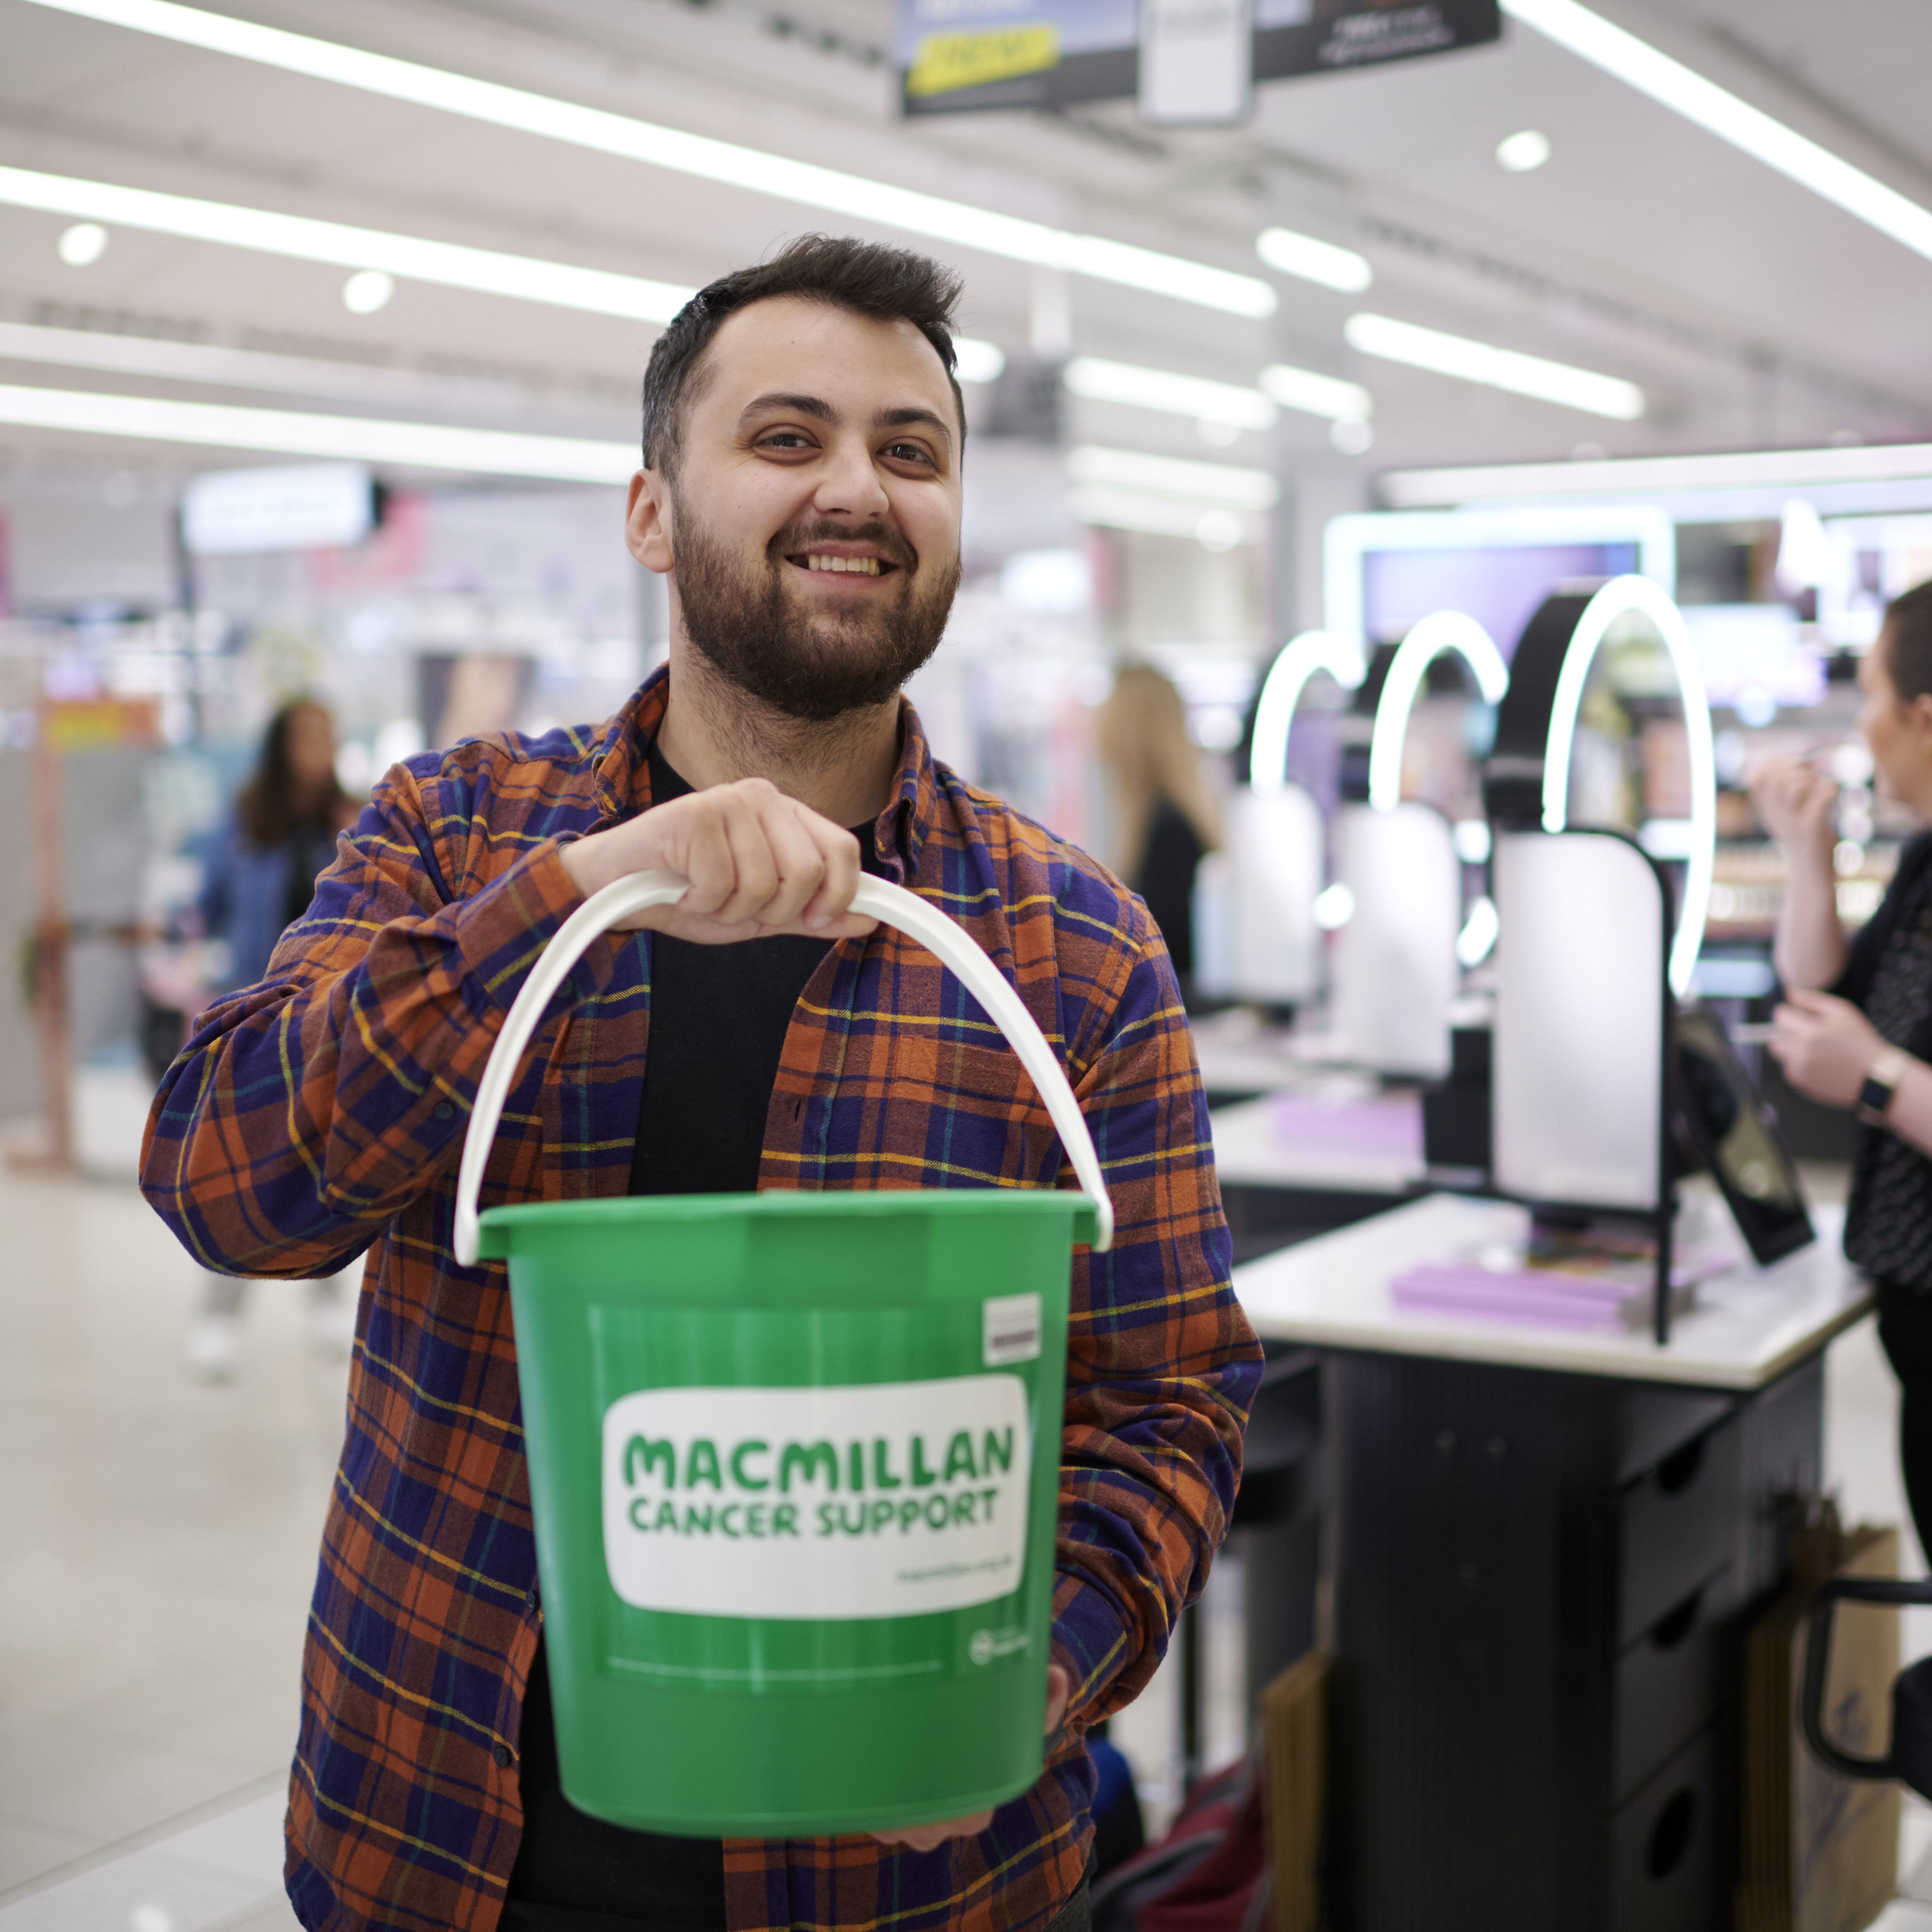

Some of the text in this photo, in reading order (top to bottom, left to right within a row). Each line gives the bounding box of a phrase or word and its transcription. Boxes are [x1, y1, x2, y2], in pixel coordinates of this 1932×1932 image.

[623, 1426, 1014, 1493] MACMILLAN
[628, 1488, 998, 1537] CANCER SUPPORT
